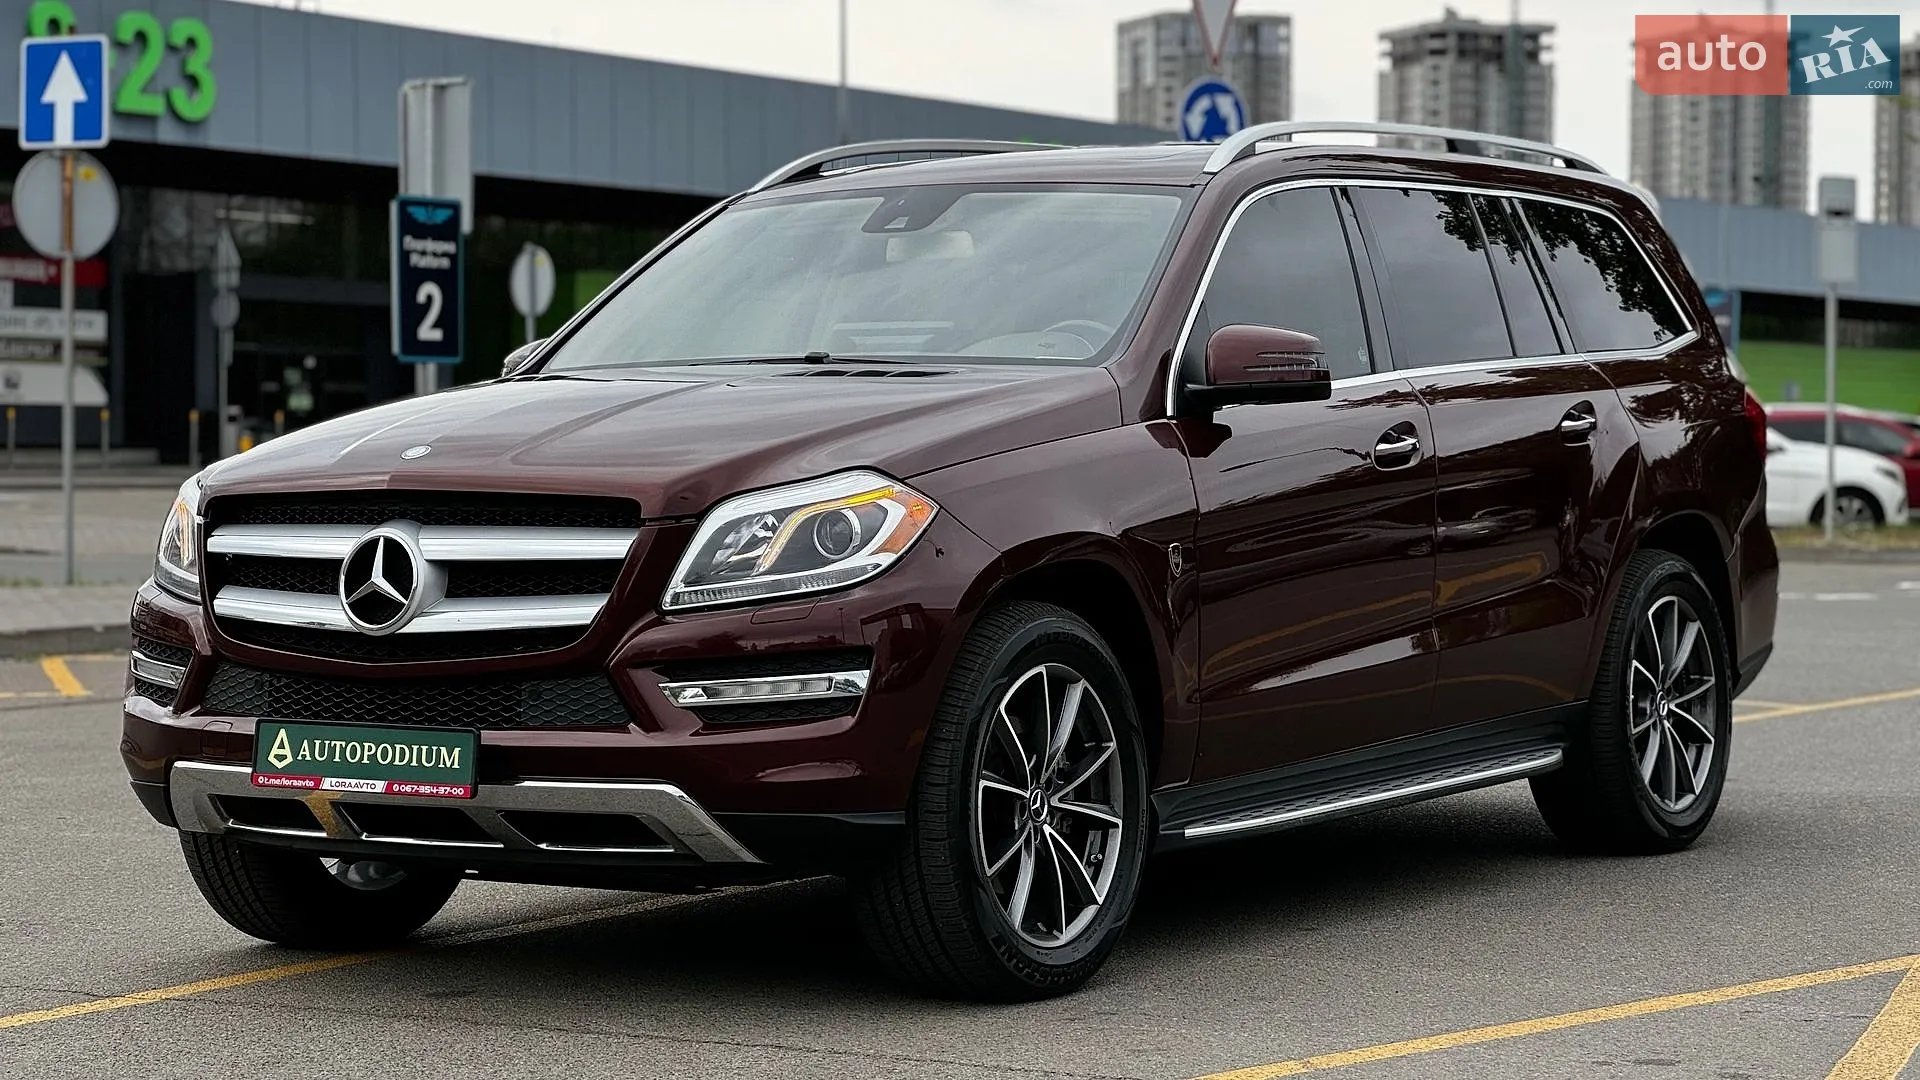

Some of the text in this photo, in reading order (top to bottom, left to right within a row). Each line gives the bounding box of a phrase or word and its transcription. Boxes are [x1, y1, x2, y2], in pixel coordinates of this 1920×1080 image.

[417, 281, 443, 341] 2
[297, 739, 461, 768] AUTOPODIUM
[330, 780, 377, 790] LORAAVTO
[400, 785, 464, 796] 067-354-37-00
